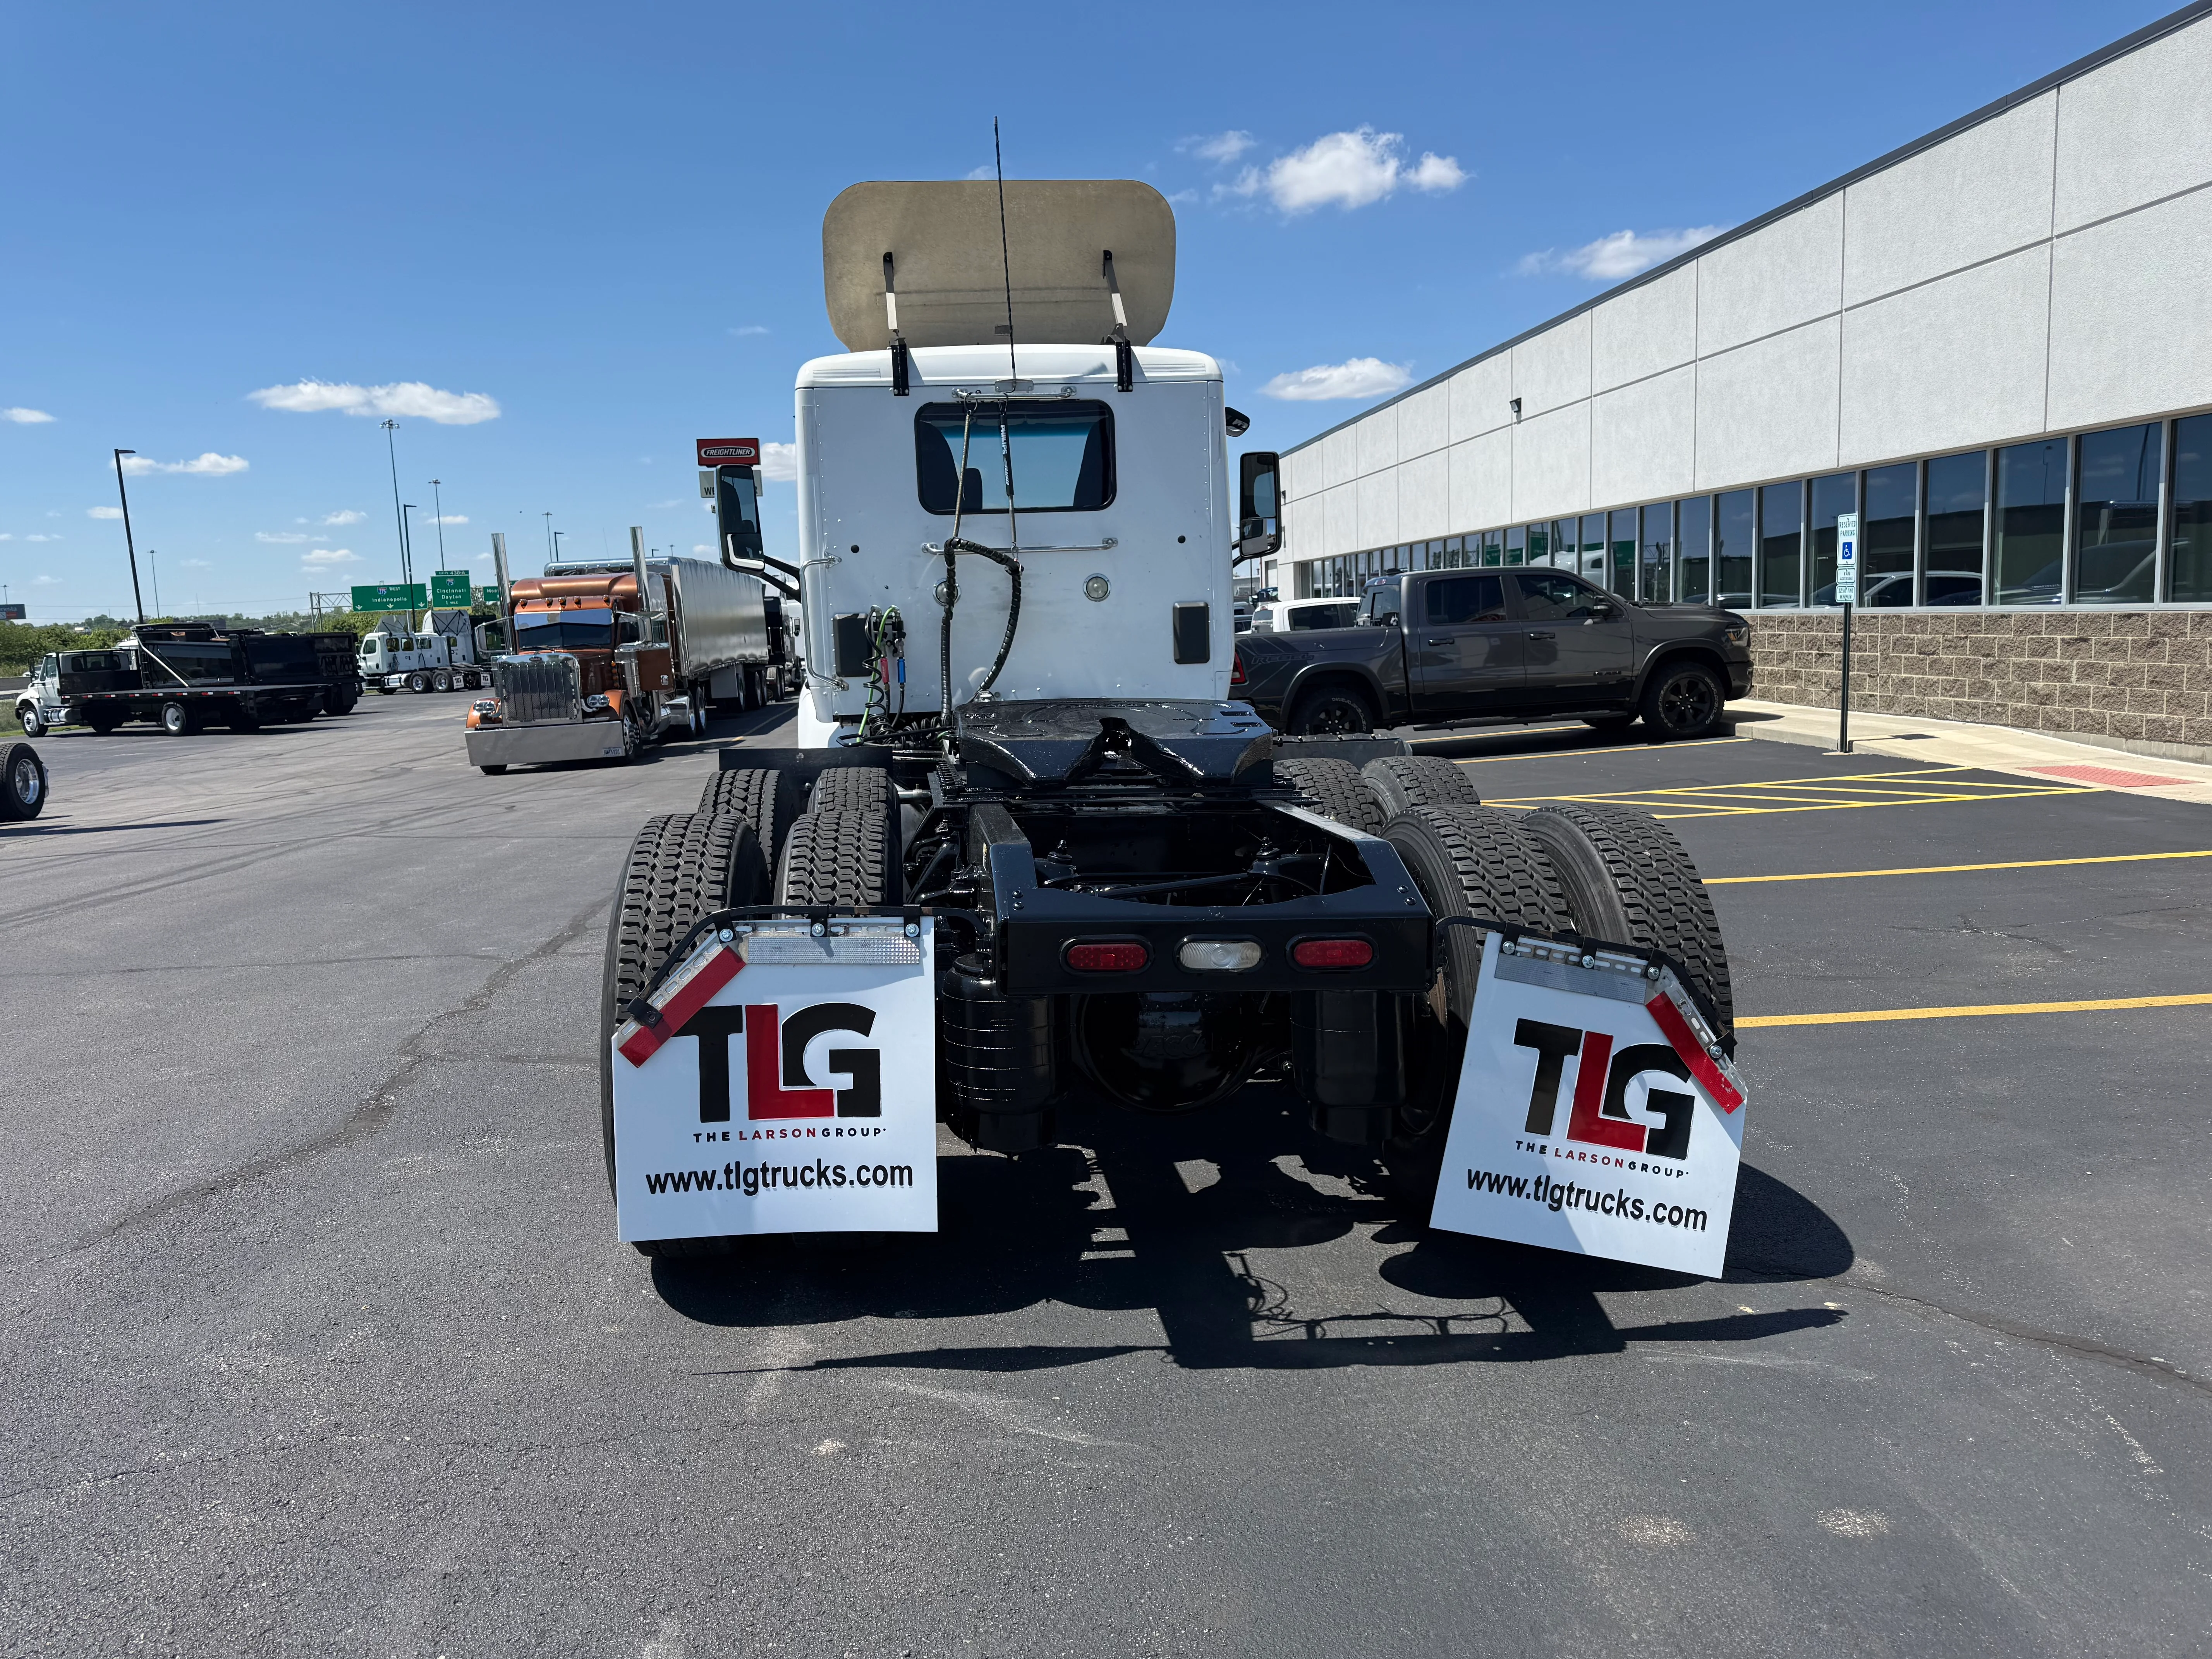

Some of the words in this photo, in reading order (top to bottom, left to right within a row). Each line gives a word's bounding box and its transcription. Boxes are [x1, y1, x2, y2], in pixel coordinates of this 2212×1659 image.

[671, 1002, 881, 1123] TLG
[1513, 1018, 1695, 1161] TLG
[693, 1132, 730, 1143] THE
[1516, 1140, 1547, 1154] THE
[646, 1158, 913, 1196] www.tlgtrucks.com
[1467, 1168, 1707, 1231] www.tlgtrucks.com
